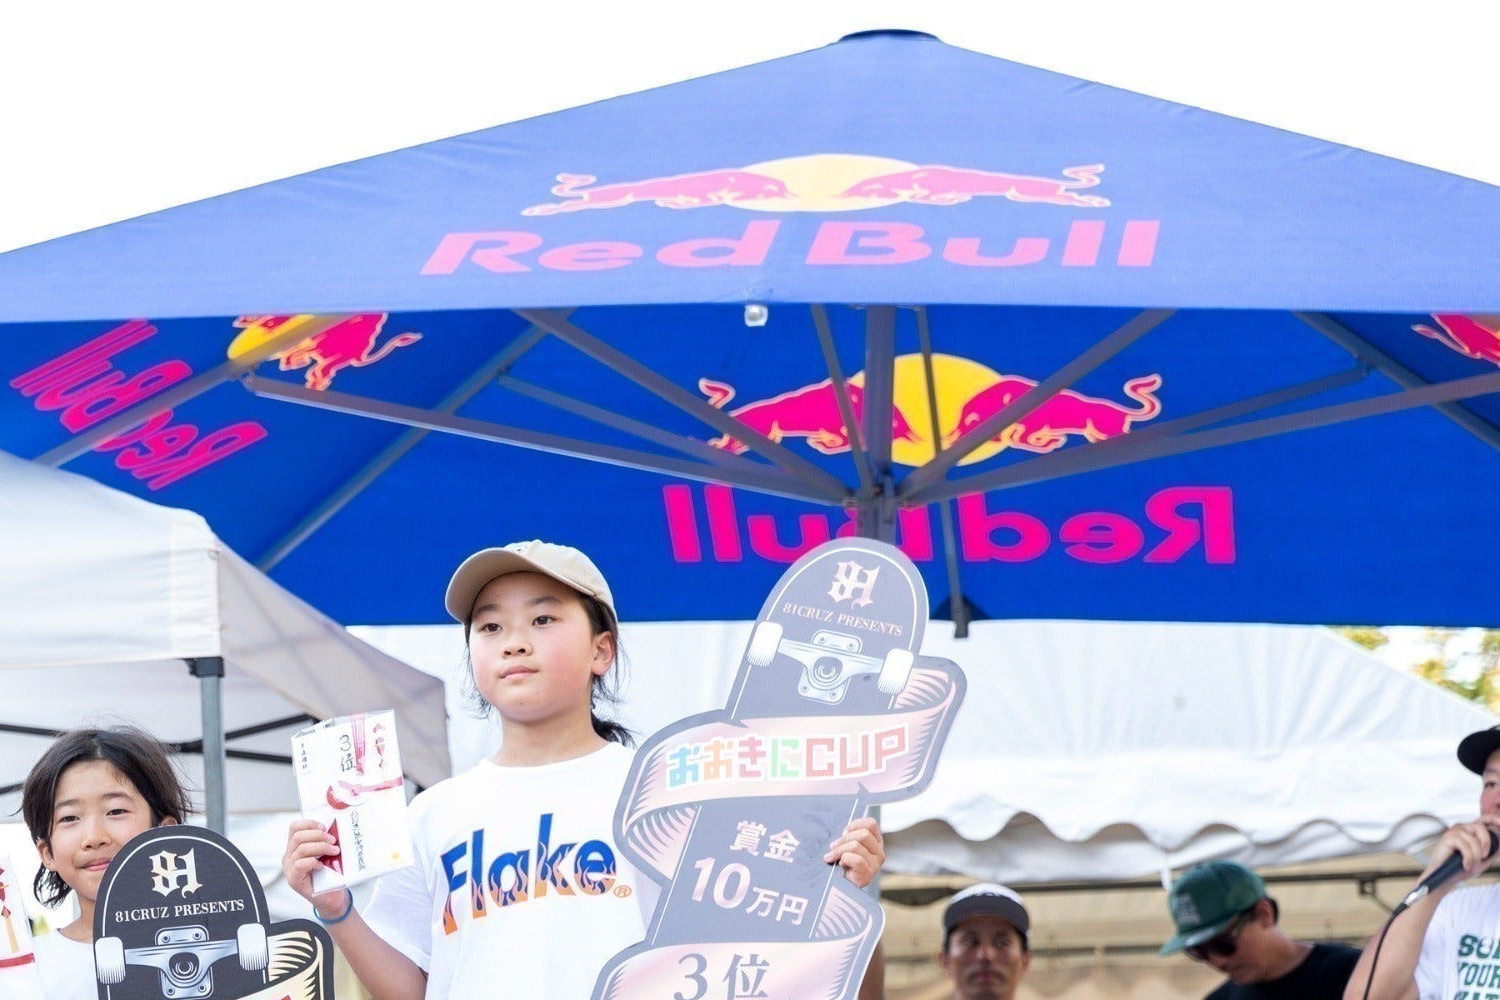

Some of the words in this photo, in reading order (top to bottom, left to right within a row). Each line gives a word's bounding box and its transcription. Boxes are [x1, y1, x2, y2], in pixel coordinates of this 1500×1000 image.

[419, 219, 781, 276] Red
[804, 219, 1160, 268] Bull
[782, 602, 833, 623] 81CRUZ
[836, 613, 904, 637] PRESENTS
[666, 724, 909, 791] おおきにCUP
[729, 819, 800, 860] 賞金
[440, 812, 617, 936] Flake
[692, 857, 809, 927] 10万円
[115, 905, 170, 923] 81CRUZ
[174, 899, 245, 917] PRESENTS
